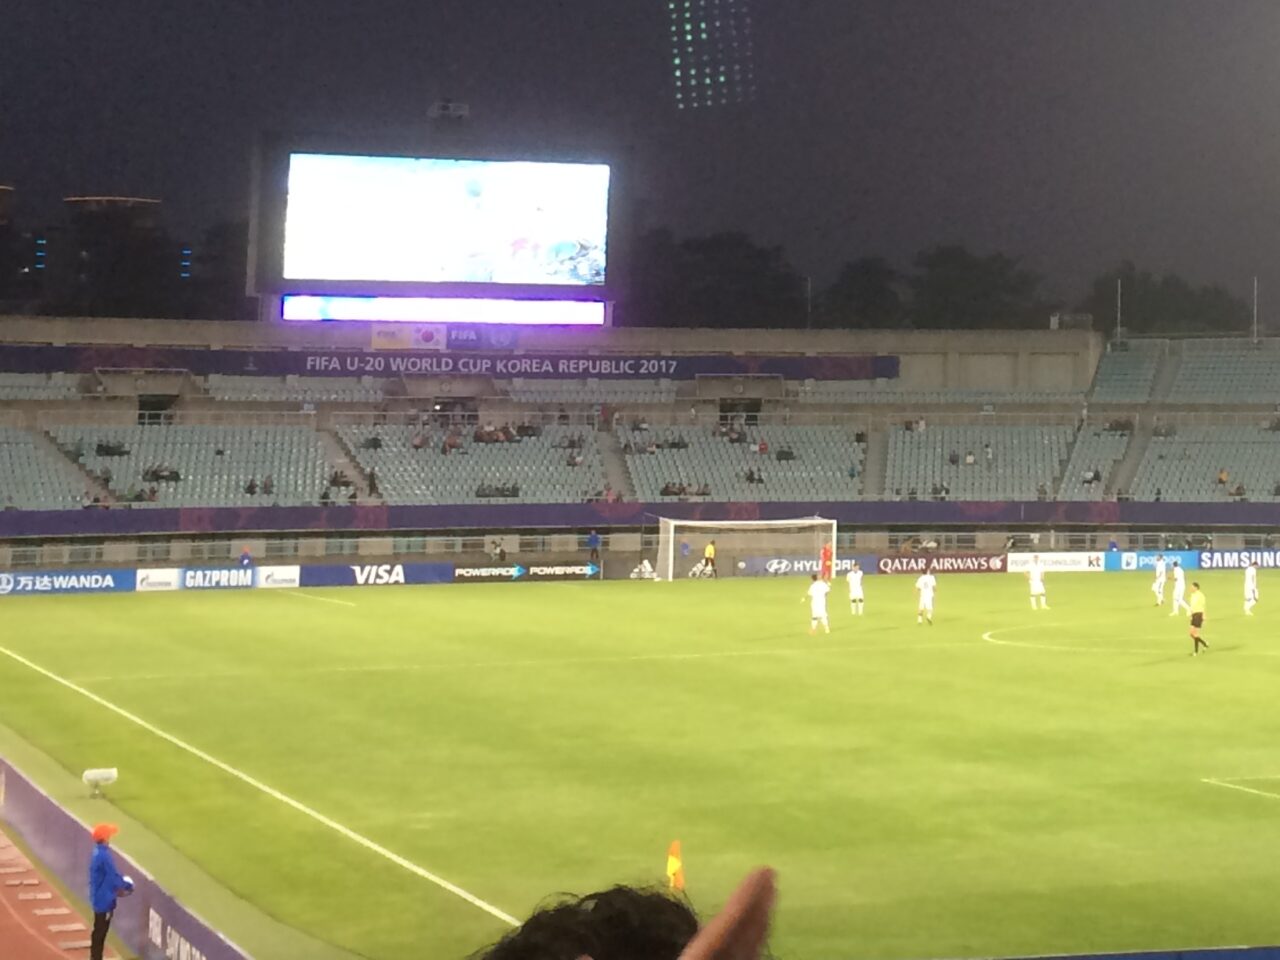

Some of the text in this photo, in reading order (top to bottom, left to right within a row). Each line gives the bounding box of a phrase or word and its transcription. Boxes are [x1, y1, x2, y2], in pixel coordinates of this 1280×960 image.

[306, 356, 677, 374] FIFA U-20 WORLD CUP KOREA REPUBLIC 2017
[793, 559, 856, 571] HYUDAI
[879, 556, 989, 572] QATAR AIRWAYS
[1087, 555, 1102, 568] kt
[16, 574, 115, 590] 万达 WANDA
[185, 569, 252, 587] GAZPROM
[350, 564, 406, 584] VISA
